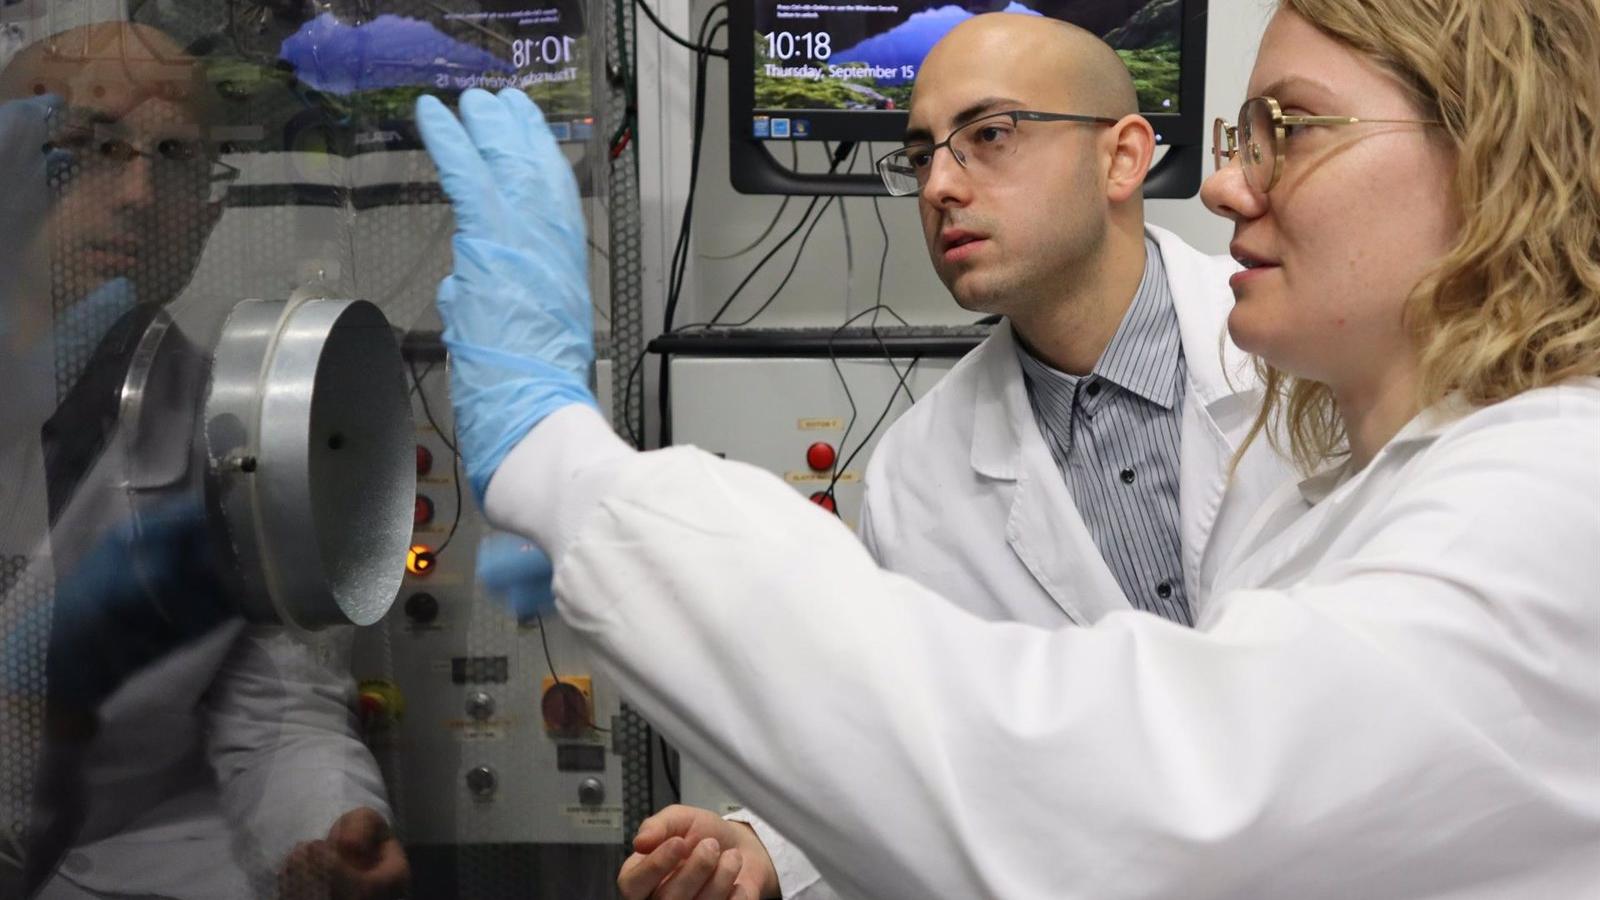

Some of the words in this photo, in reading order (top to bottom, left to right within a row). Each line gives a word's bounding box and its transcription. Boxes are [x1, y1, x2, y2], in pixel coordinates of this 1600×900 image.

[764, 31, 832, 60] 10:18
[764, 64, 825, 80] Thursday,
[828, 65, 897, 80] September
[901, 65, 915, 78] 15
